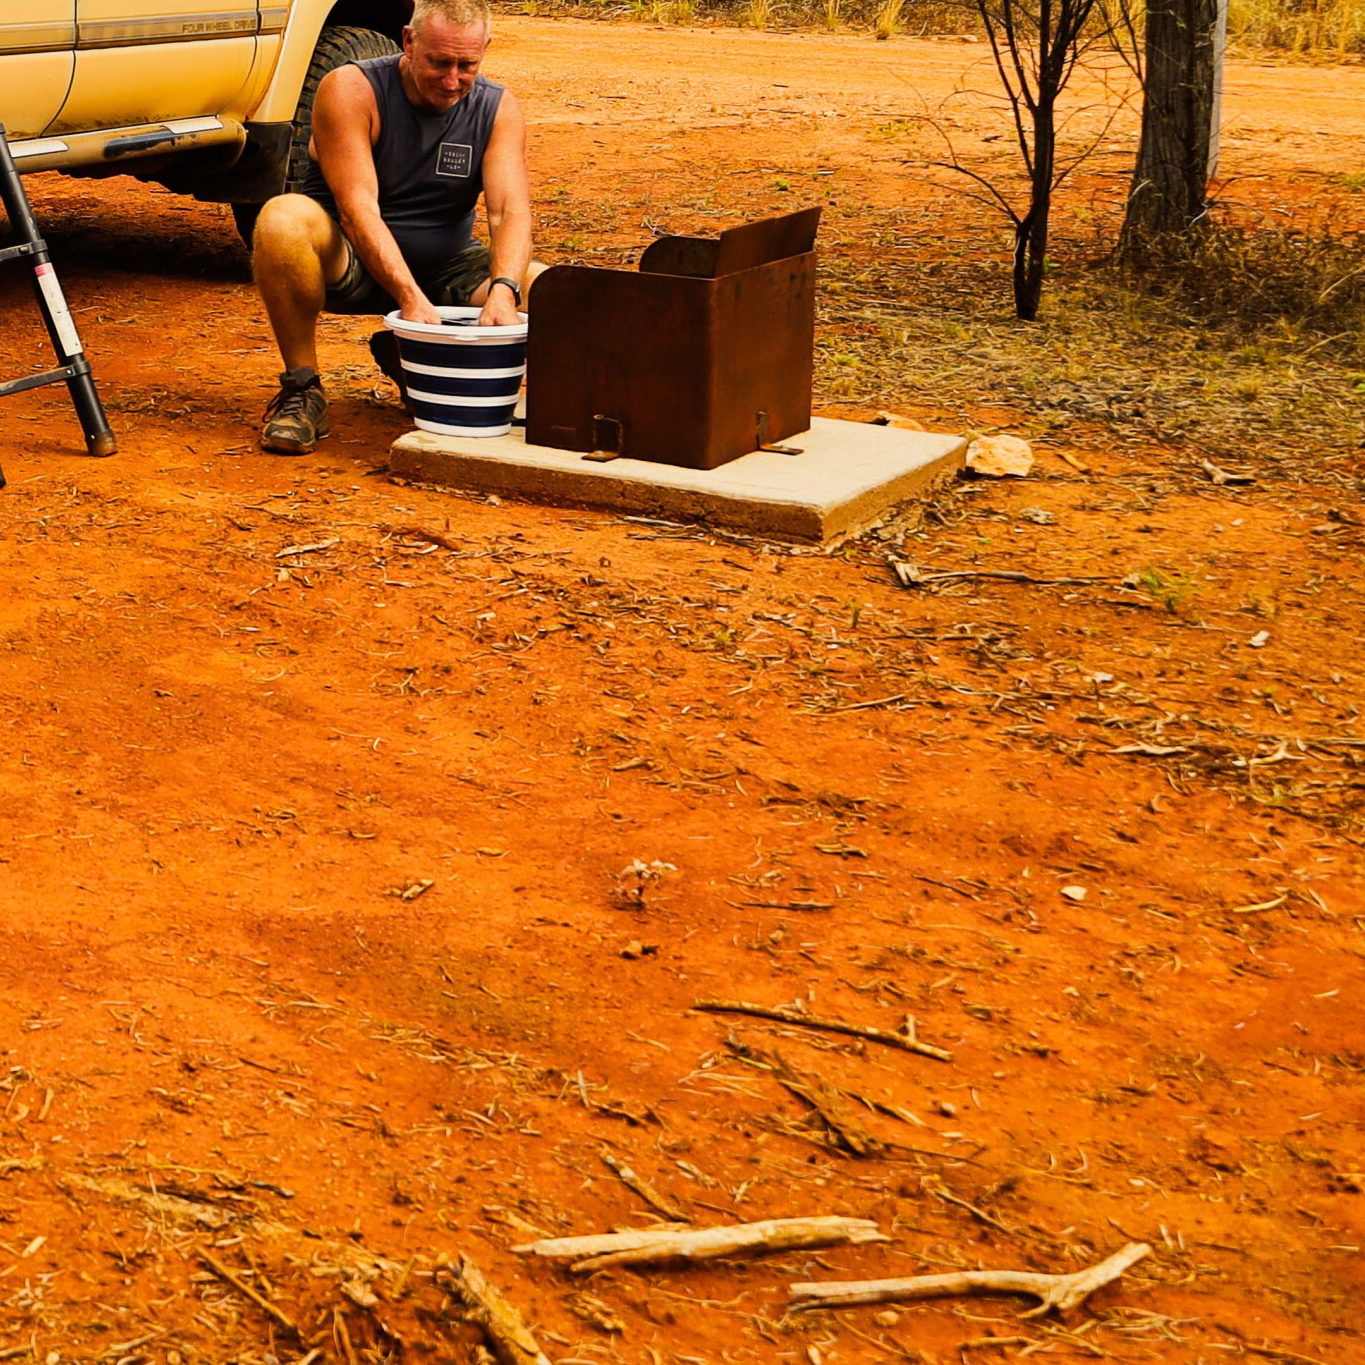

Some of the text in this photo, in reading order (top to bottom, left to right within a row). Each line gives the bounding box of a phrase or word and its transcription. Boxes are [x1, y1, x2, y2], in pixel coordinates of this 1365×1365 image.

[182, 18, 257, 34] FOUR WHEEL DRIVE
